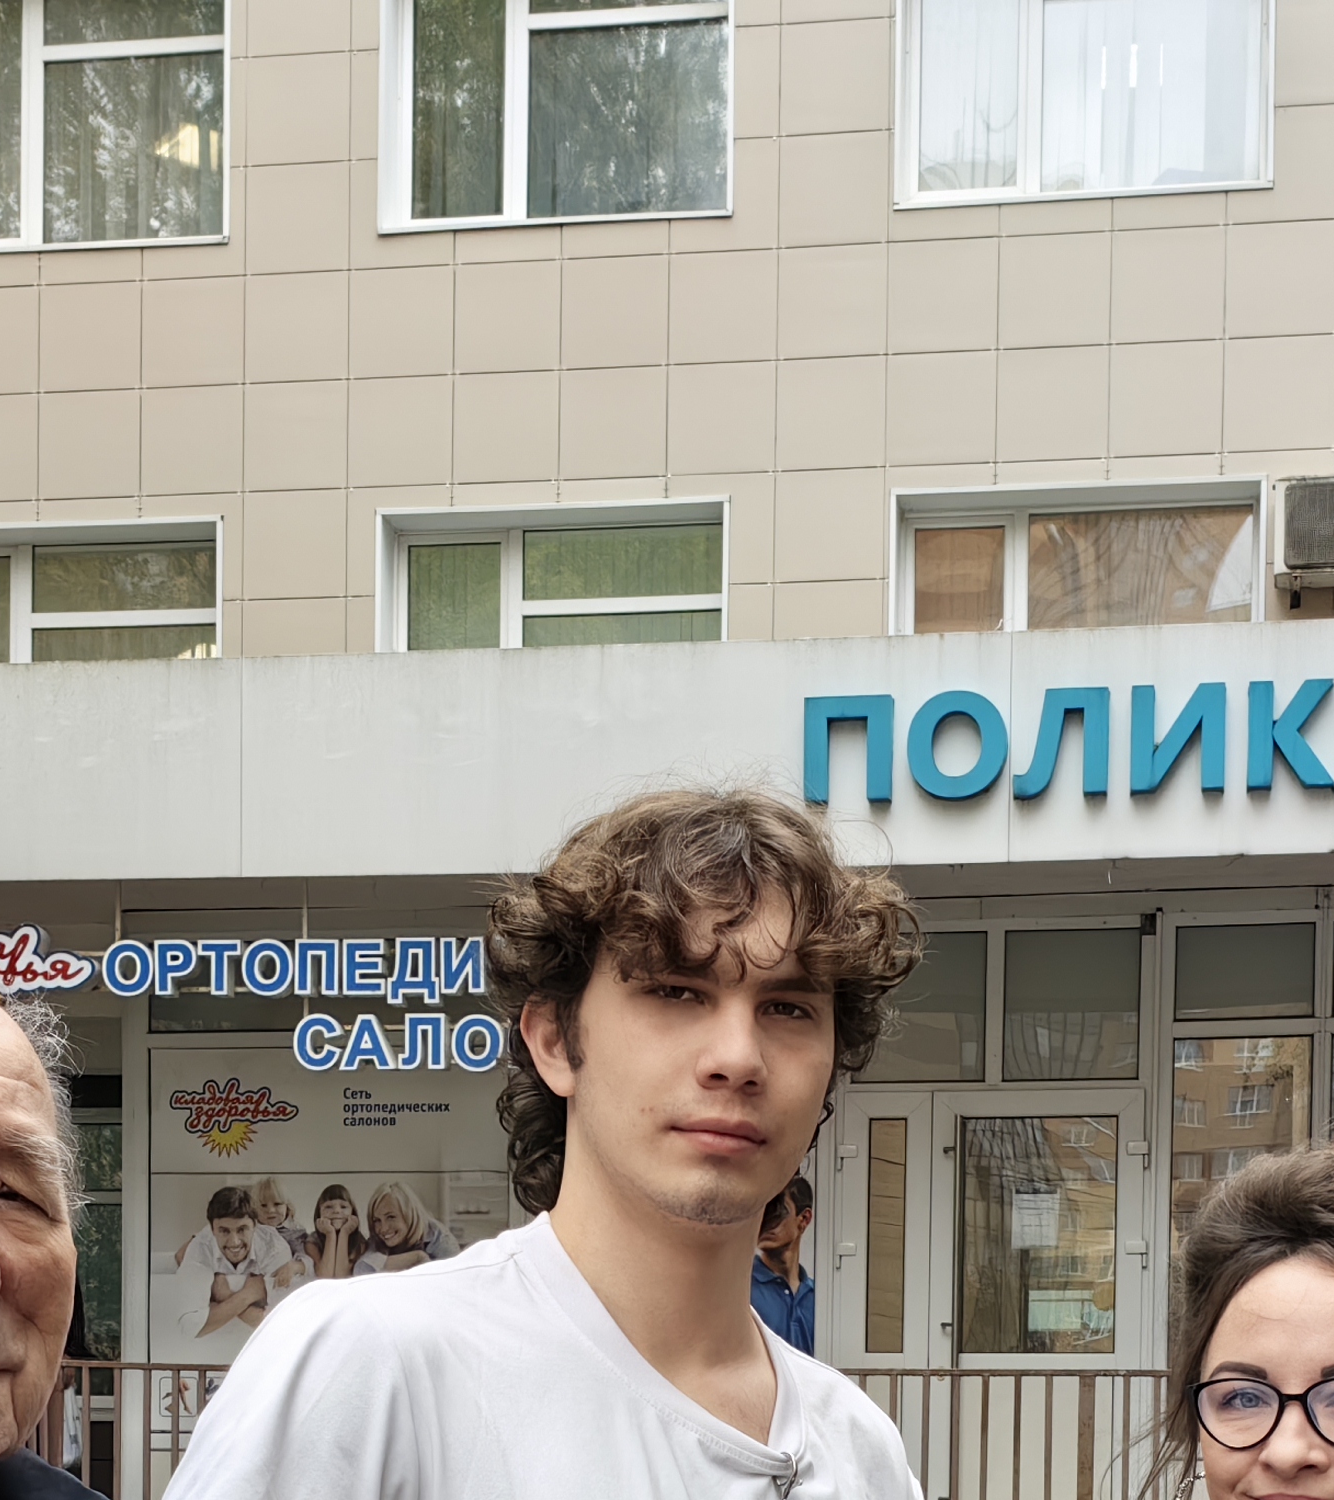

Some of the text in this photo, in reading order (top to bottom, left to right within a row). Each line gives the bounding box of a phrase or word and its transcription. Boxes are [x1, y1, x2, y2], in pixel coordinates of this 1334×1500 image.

[104, 937, 485, 1004] ОРТОПЕДИ
[293, 1013, 505, 1072] САЛО
[343, 1087, 372, 1101] Сеть
[343, 1102, 451, 1116] ортопедических
[343, 1116, 397, 1127] салонов
